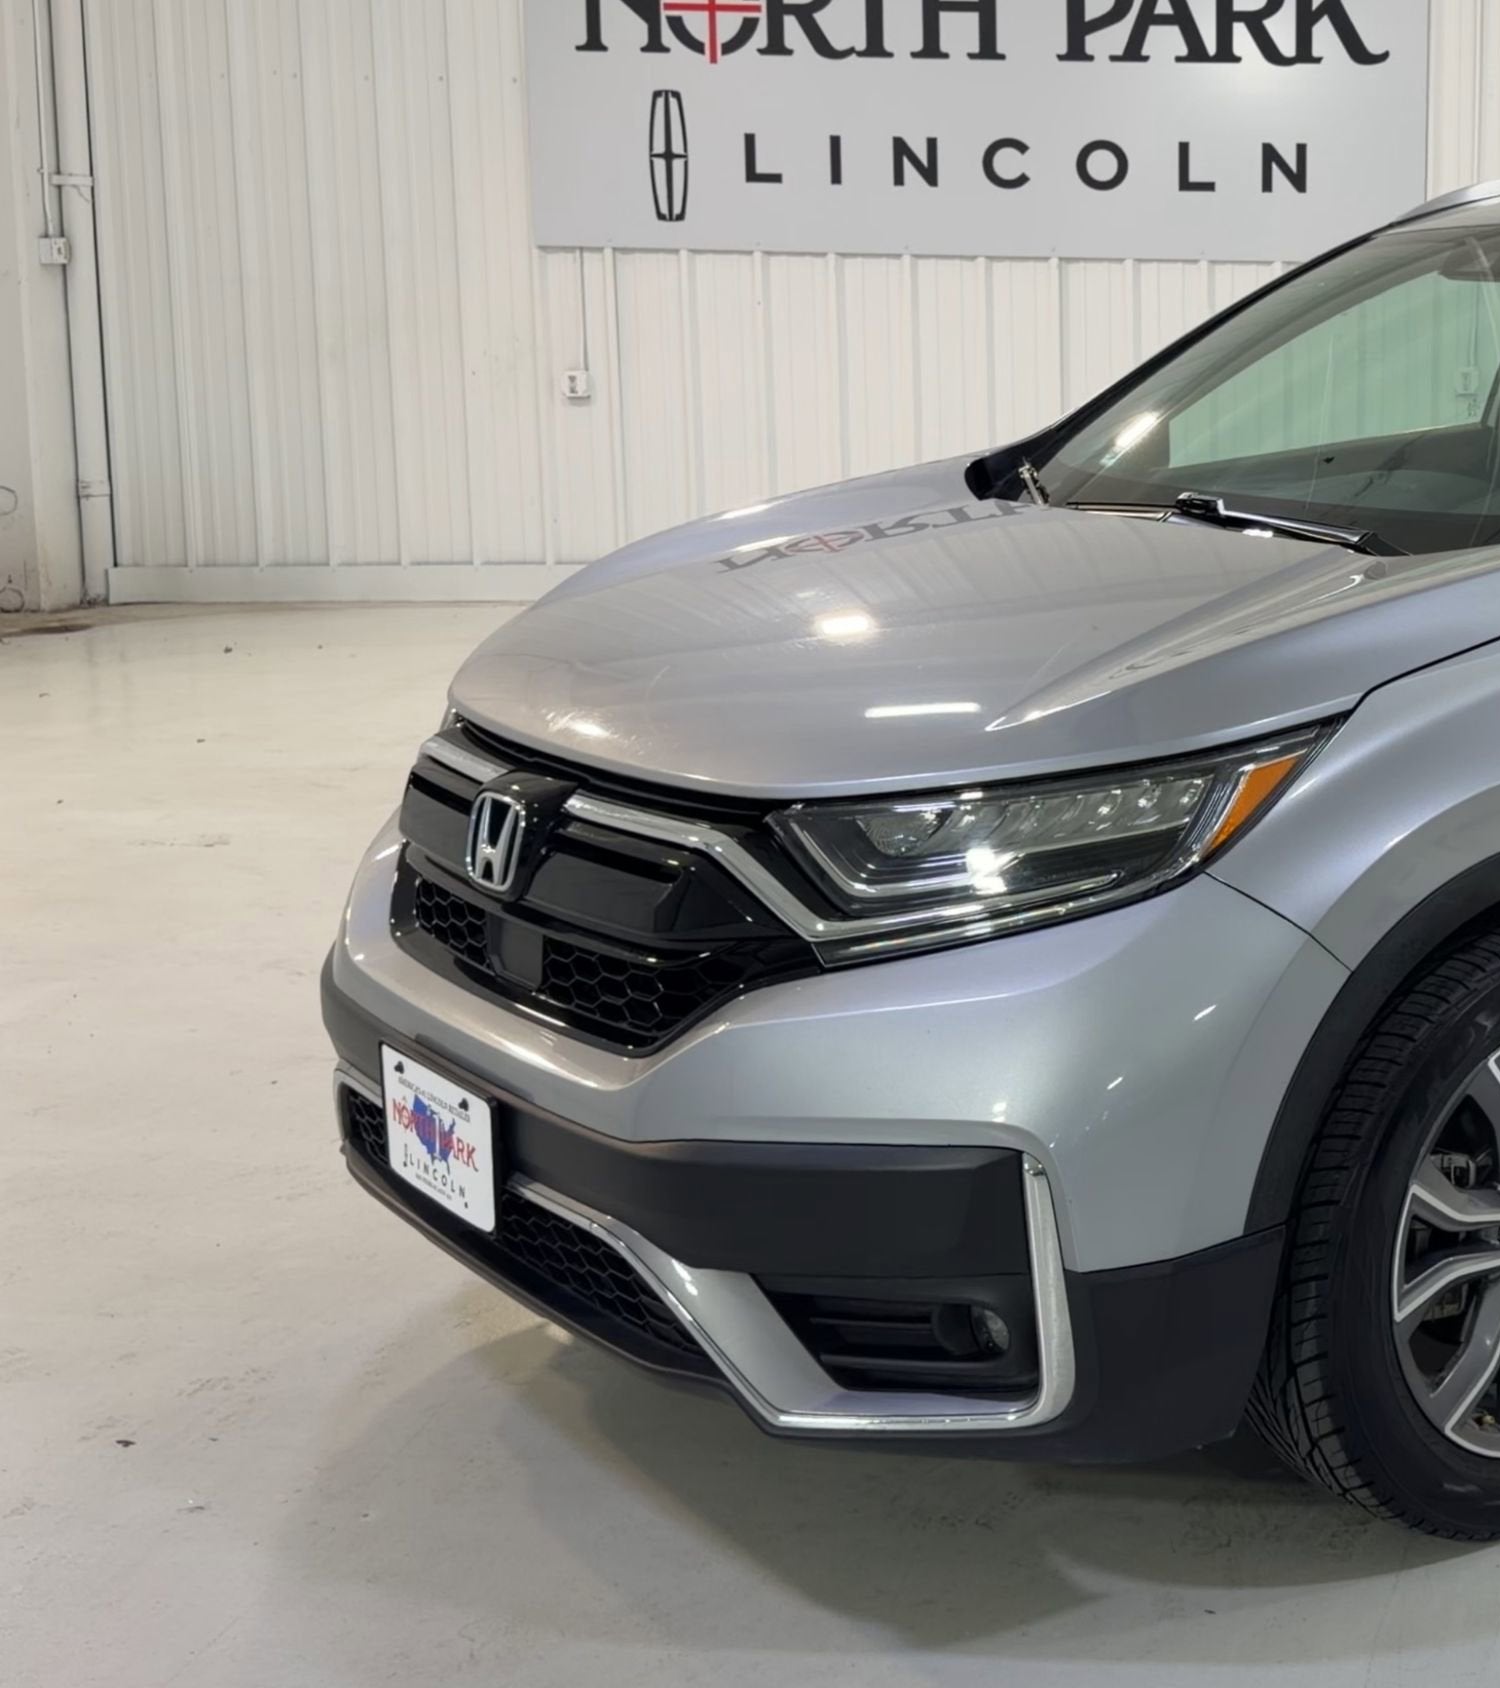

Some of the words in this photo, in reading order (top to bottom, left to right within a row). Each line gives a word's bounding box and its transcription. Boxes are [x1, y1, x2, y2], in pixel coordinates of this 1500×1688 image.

[1056, 0, 1390, 66] PARK
[744, 132, 1309, 194] LINCOLN
[409, 1152, 466, 1199] LINCOLN
